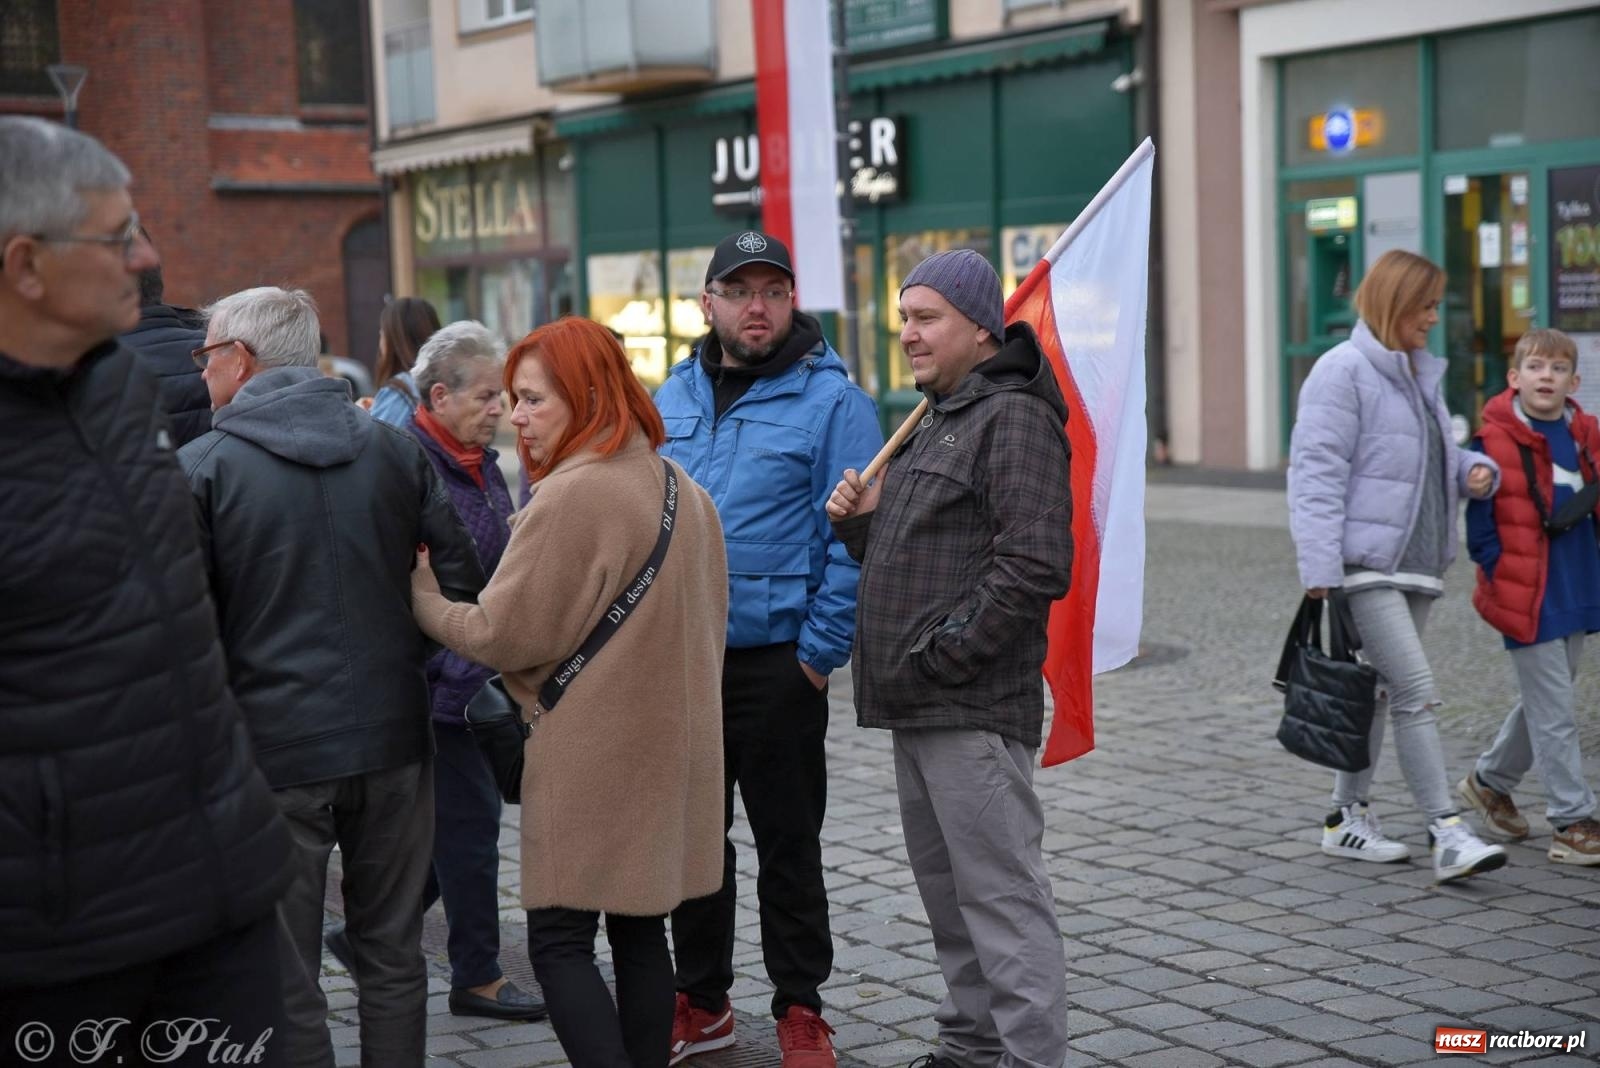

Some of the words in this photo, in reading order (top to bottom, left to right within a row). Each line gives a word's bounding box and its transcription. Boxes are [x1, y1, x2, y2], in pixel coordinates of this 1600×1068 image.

[416, 181, 537, 242] STELLA
[666, 475, 677, 511] design
[627, 566, 655, 604] design
